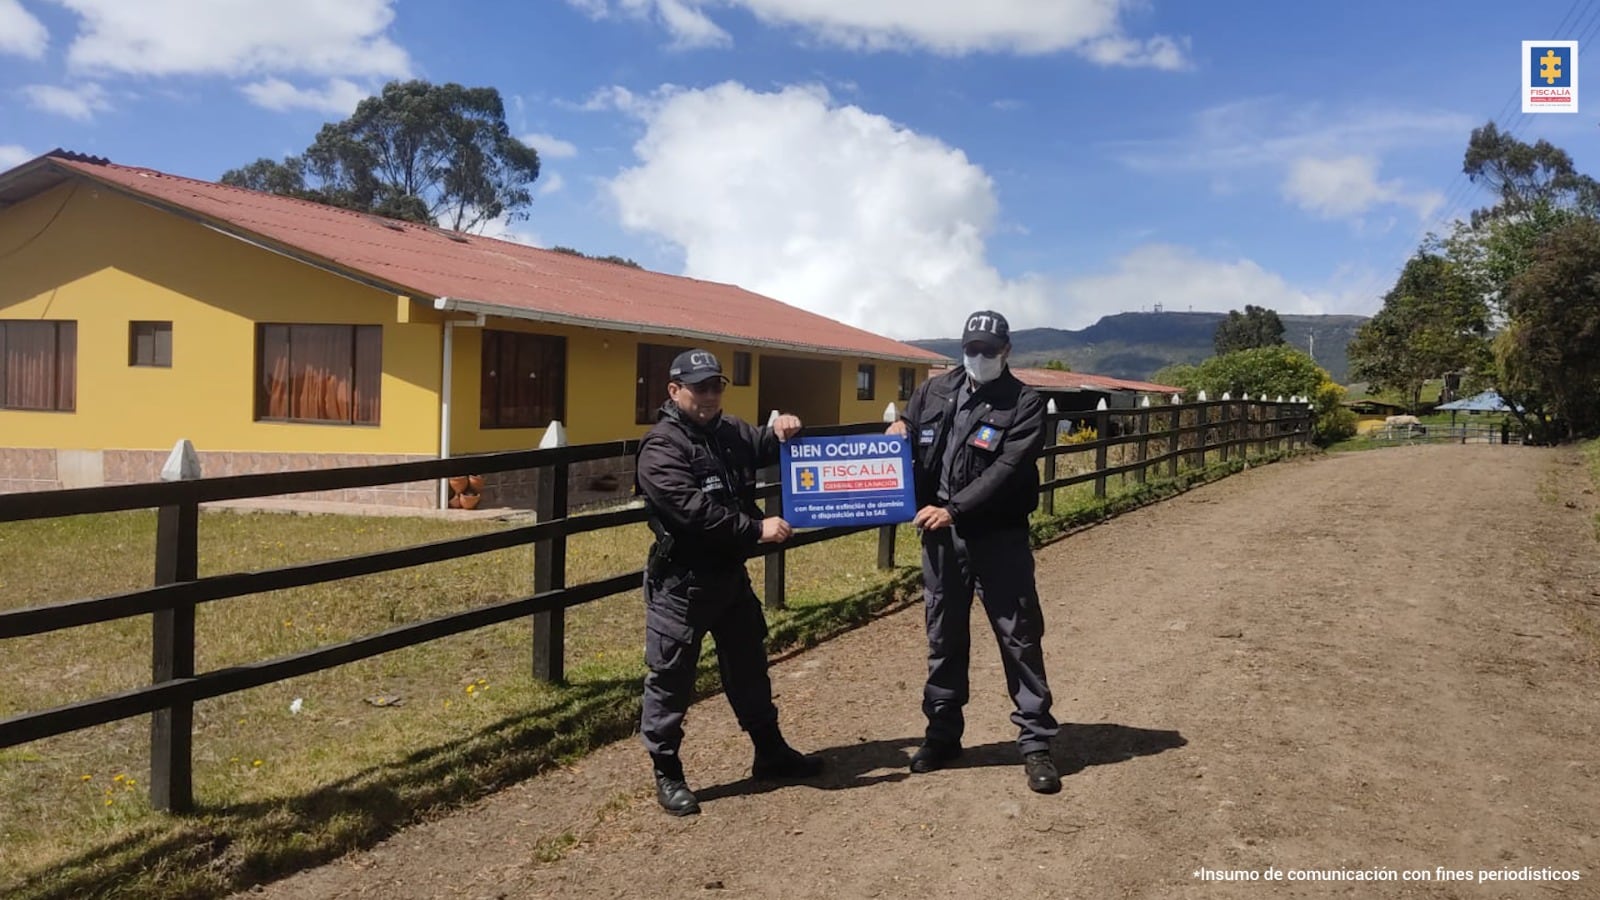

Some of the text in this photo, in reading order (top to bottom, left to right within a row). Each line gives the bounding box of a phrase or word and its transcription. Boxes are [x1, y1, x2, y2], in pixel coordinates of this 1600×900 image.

[968, 315, 998, 334] CTI
[791, 441, 901, 457] BIEN OCUPADO
[878, 500, 904, 508] dominio
[855, 510, 865, 518] de
